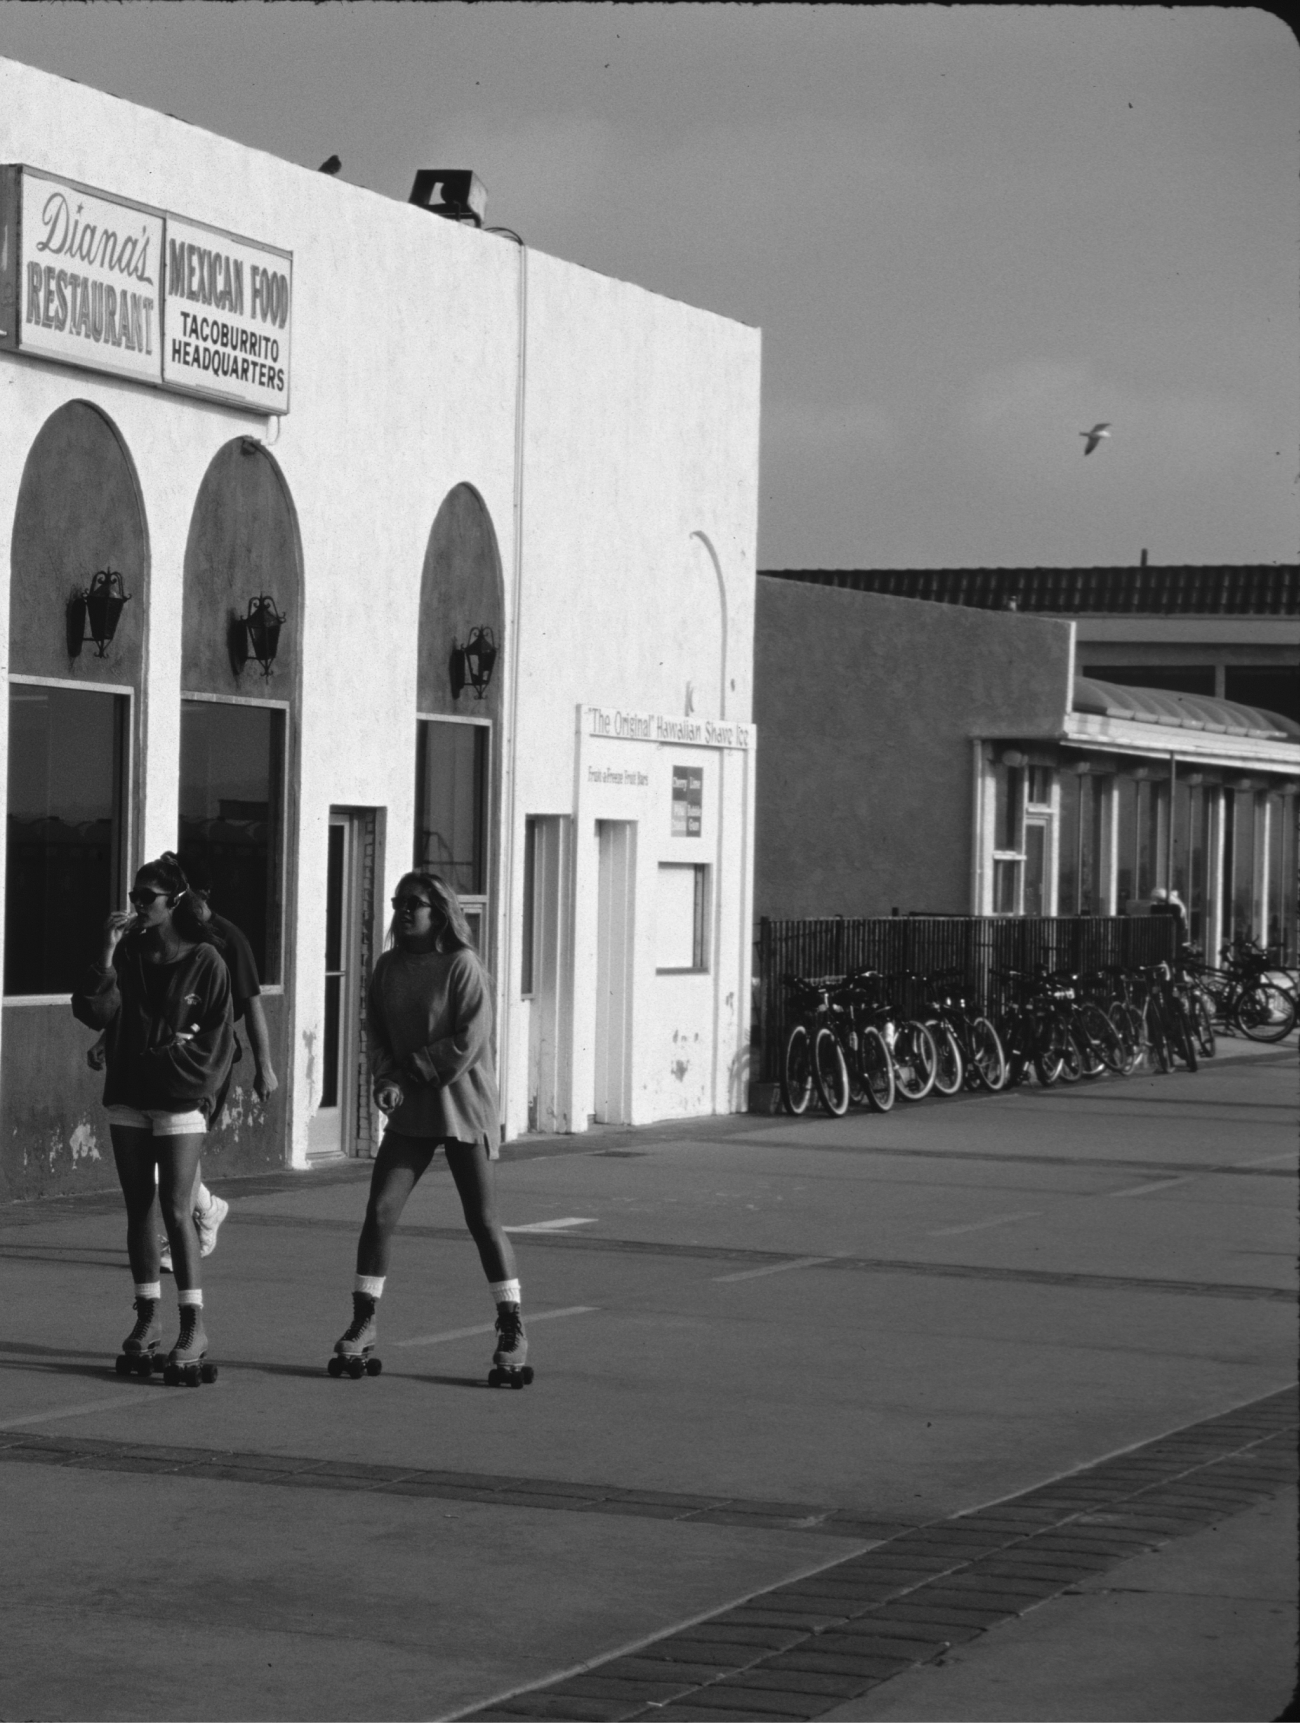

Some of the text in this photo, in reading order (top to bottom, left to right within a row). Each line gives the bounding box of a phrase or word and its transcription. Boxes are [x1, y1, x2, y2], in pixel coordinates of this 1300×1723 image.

[36, 192, 154, 286] Diana's
[26, 261, 154, 356] RESTAURANT
[168, 238, 289, 330] MEXICAN FOOD
[172, 338, 284, 392] HEADQUARTERS
[180, 311, 279, 363] TACOBURRITO
[657, 716, 700, 742] Hawaiian
[705, 721, 733, 746] Shave
[736, 725, 749, 747] Ice
